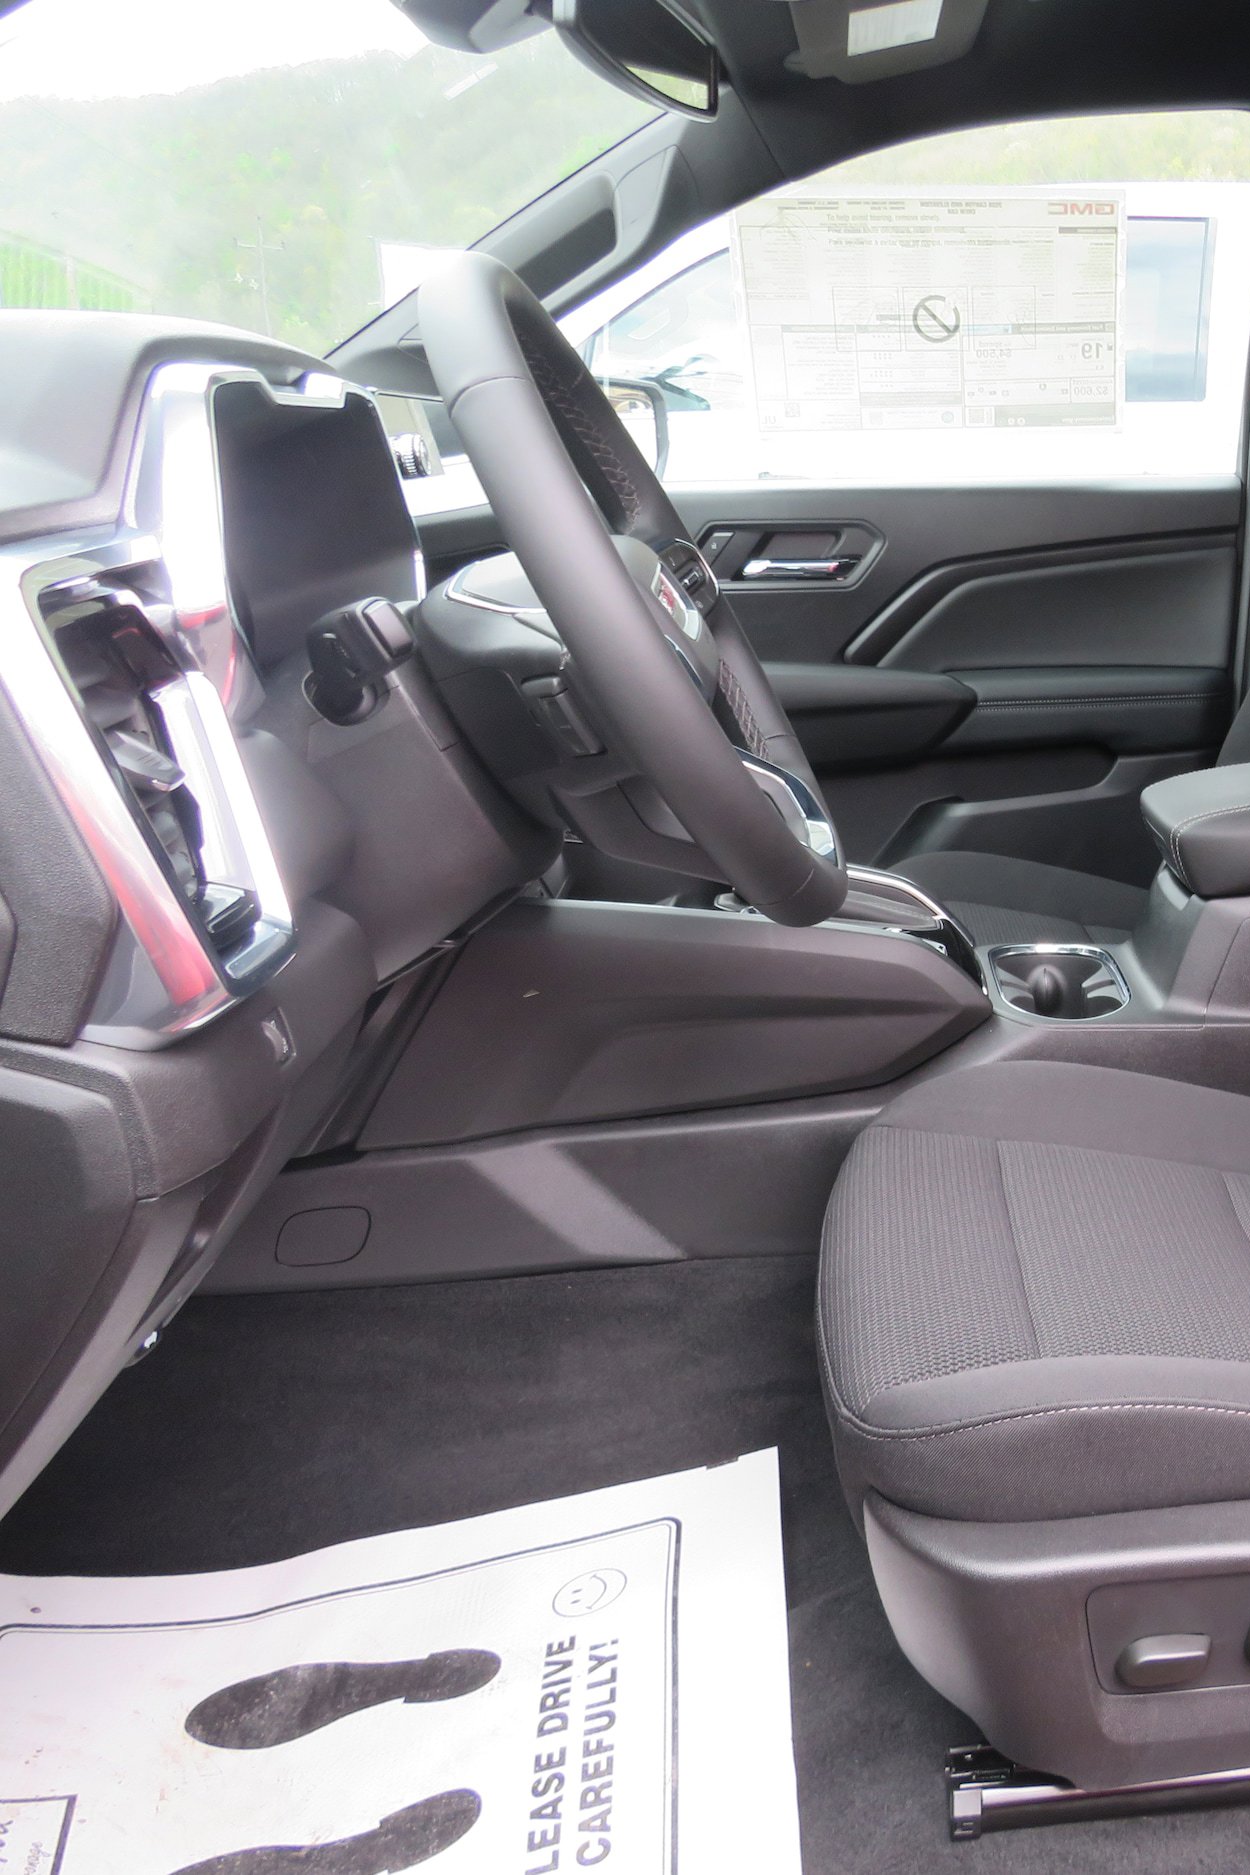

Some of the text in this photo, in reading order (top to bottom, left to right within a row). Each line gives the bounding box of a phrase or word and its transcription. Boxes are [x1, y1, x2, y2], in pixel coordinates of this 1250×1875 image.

[524, 1634, 577, 1875] LEASE DRIVE
[575, 1638, 620, 1867] CAREFULLY!
